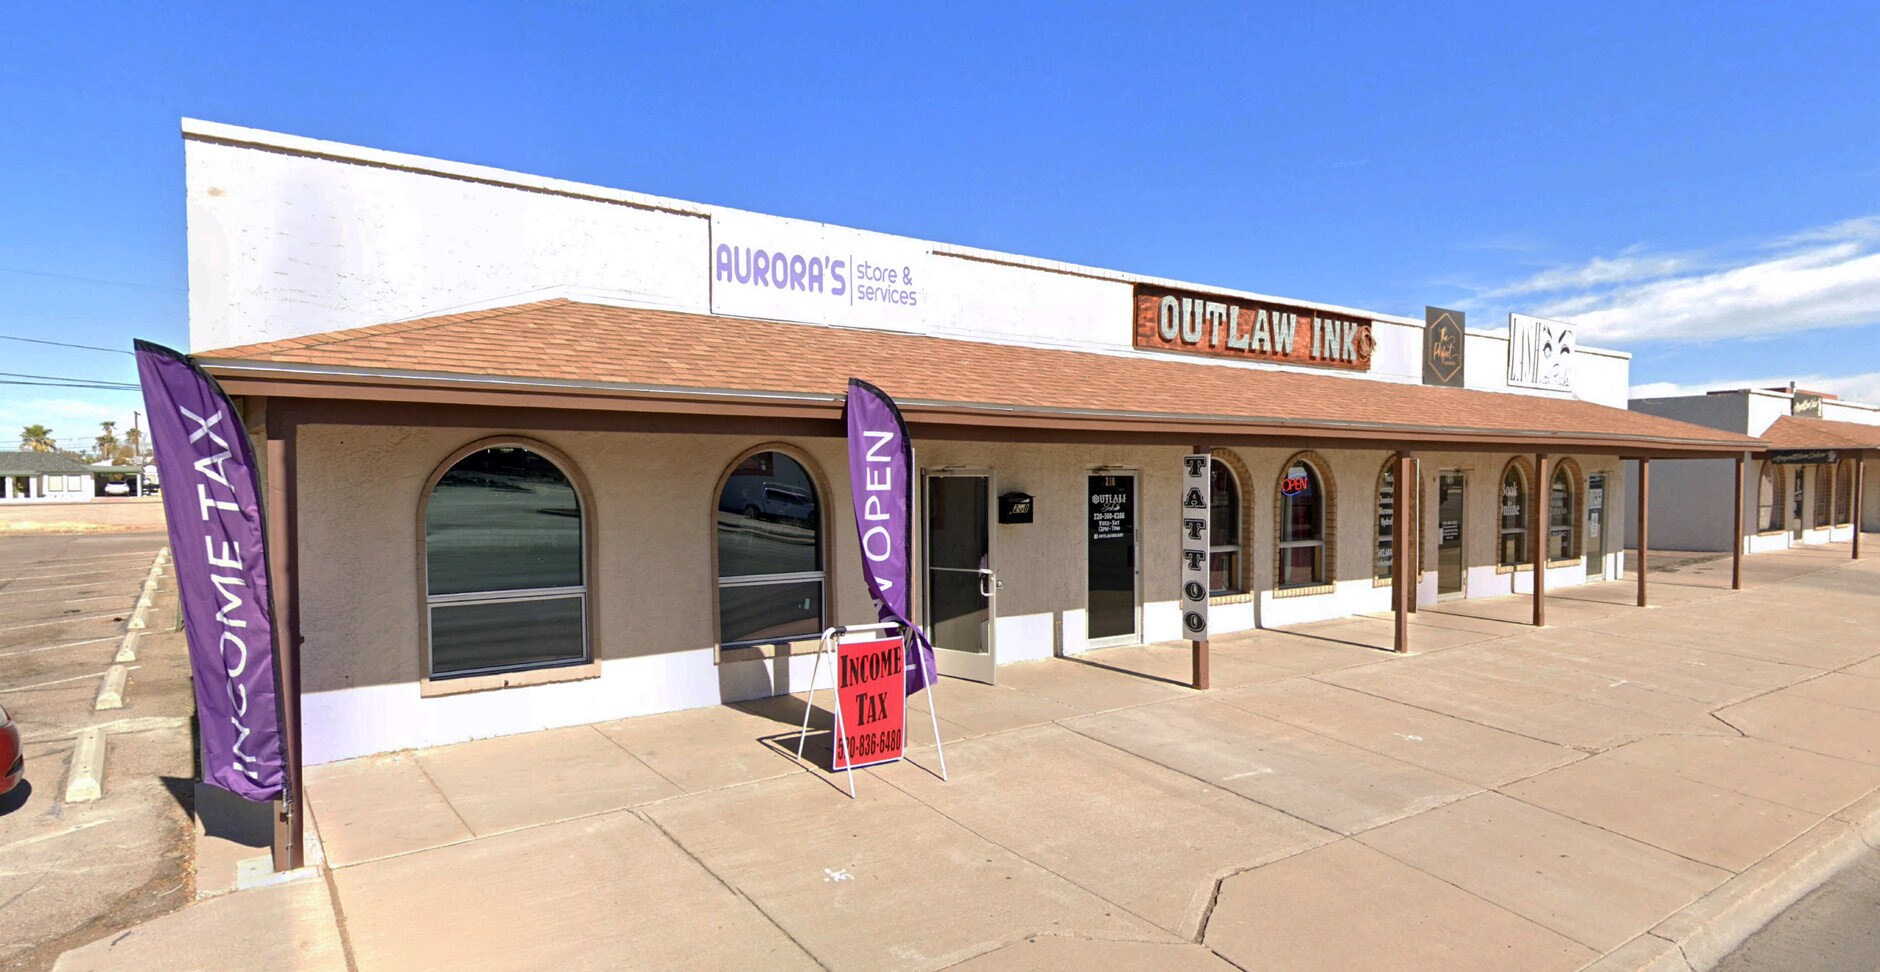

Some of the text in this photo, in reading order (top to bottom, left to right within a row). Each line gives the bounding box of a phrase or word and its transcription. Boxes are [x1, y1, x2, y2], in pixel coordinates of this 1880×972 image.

[716, 244, 846, 296] AURORA'S
[857, 261, 913, 286] store &
[857, 284, 917, 306] services
[1159, 295, 1358, 361] OUTLAW INK
[862, 431, 894, 562] OPEN
[1282, 477, 1308, 492] OPEN
[1502, 501, 1520, 515] nline
[1183, 456, 1206, 632] TATTOO
[180, 405, 258, 779] INCOME TAX
[840, 646, 901, 689] INCOME
[856, 692, 888, 727] TAX
